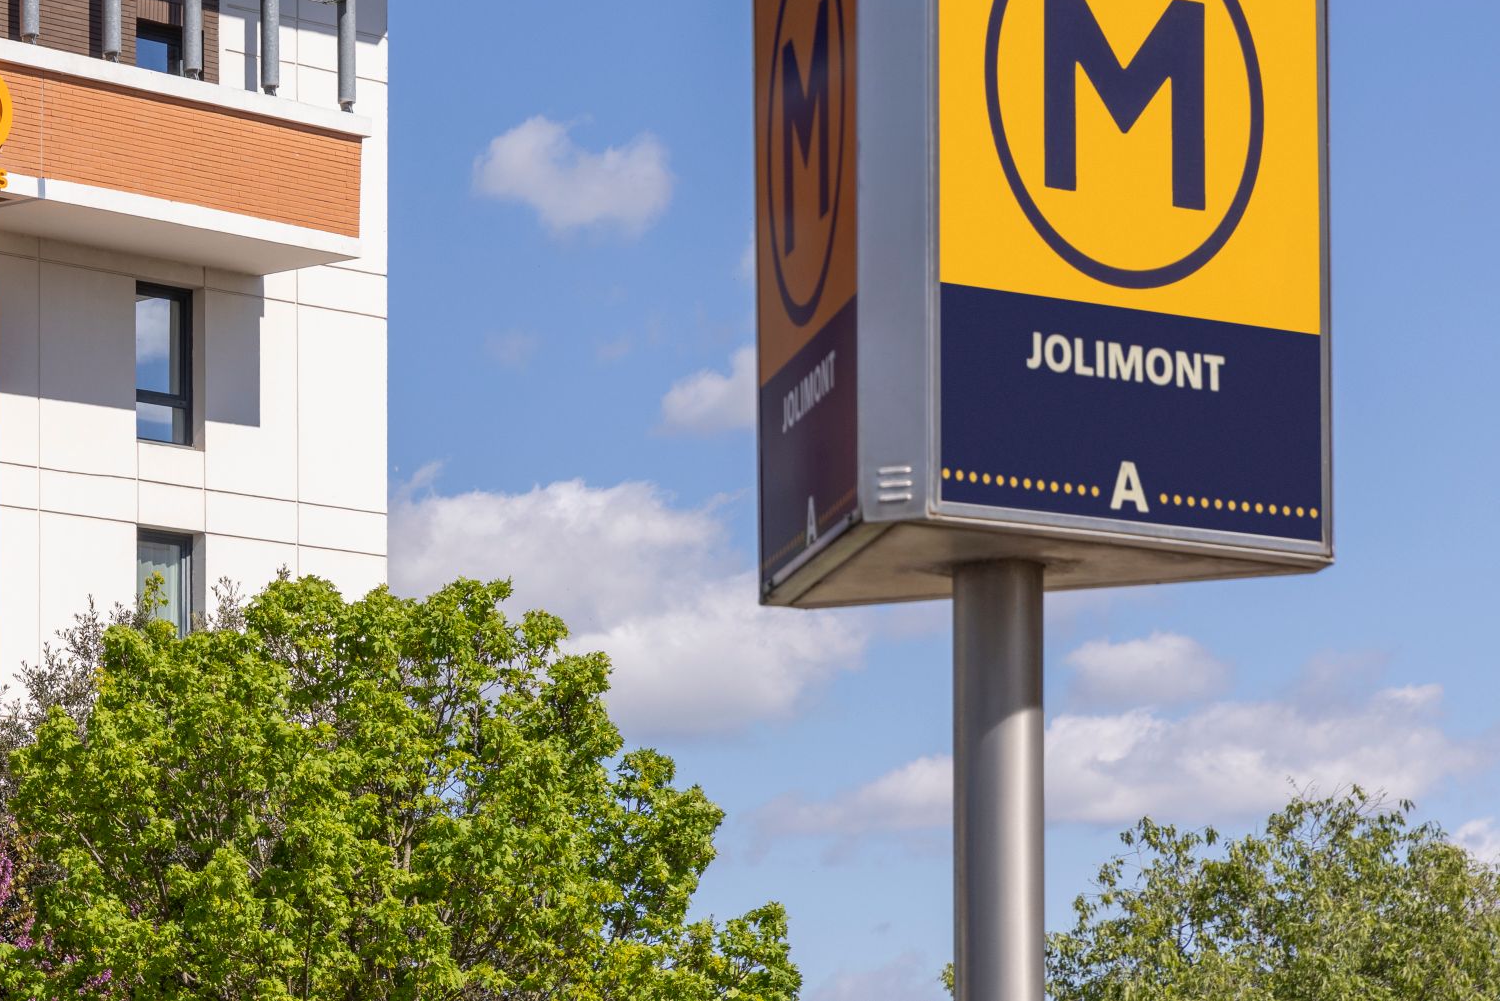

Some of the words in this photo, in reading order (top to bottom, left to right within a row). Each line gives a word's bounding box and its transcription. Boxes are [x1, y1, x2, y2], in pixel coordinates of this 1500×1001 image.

[1026, 331, 1225, 392] JOLIMONT
[781, 350, 837, 434] JOLIMONT
[1111, 461, 1150, 514] A
[805, 496, 819, 547] A
